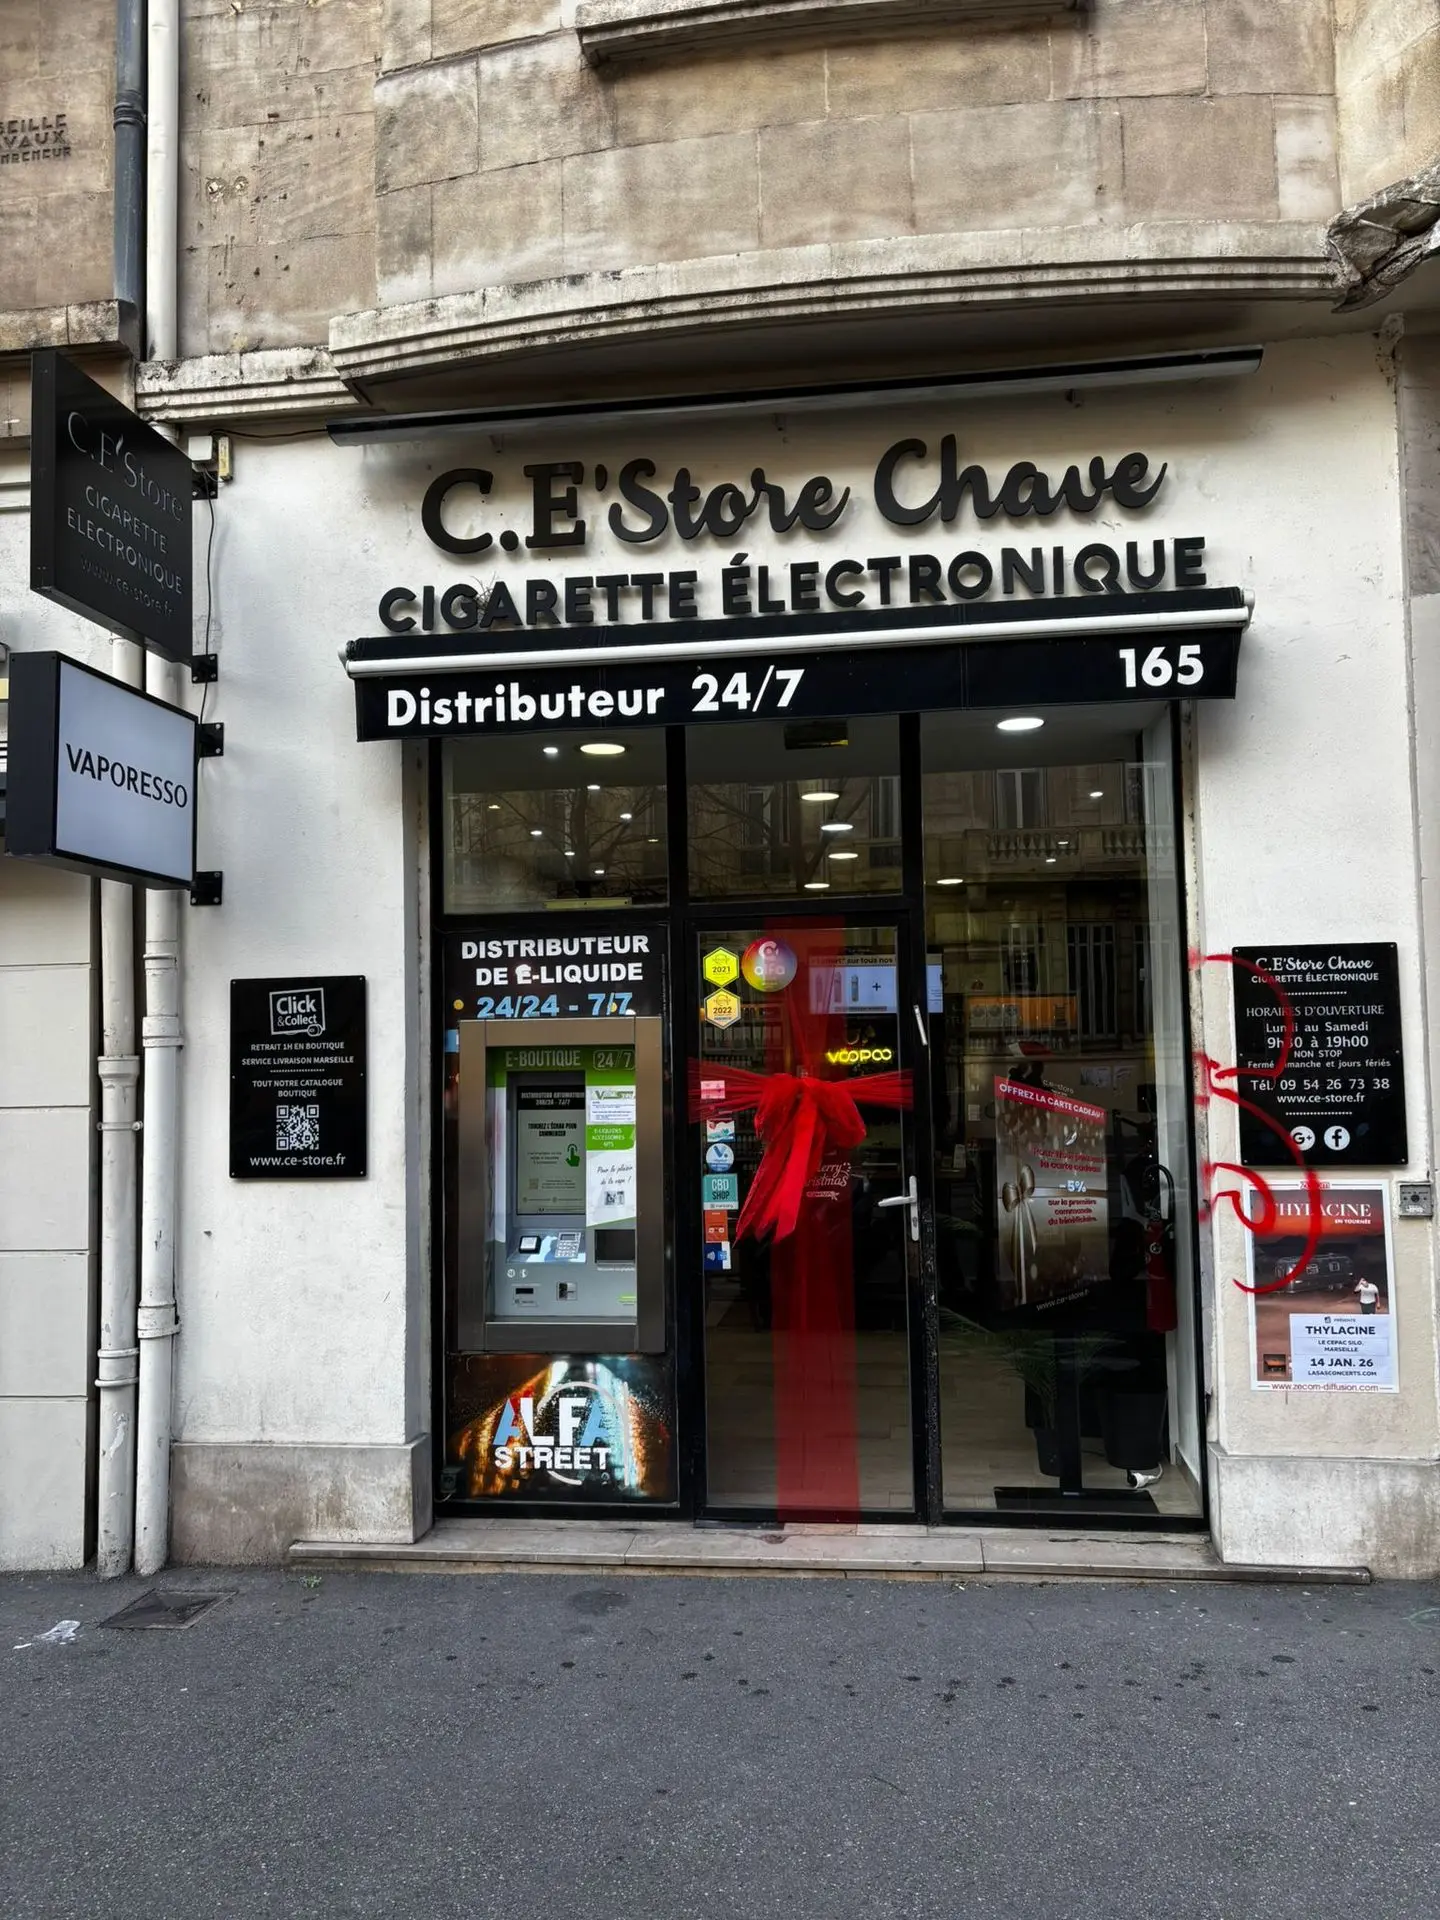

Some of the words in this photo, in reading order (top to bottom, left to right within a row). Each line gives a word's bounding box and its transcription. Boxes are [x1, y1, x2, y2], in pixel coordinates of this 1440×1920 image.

[0, 130, 66, 148] VAUX
[67, 411, 184, 522] C.E'Store
[420, 456, 851, 557] C.E'Store
[873, 433, 1168, 527] Chave
[85, 485, 168, 555] CIGARETTE
[67, 507, 183, 595] ELECTRONIQUE
[378, 569, 699, 635] CIGARETTE
[722, 536, 1208, 617] ÉLECTRONIQUE
[386, 680, 665, 728] Distributeur
[690, 668, 805, 714] 24/7
[1118, 644, 1205, 689] 165
[66, 743, 188, 809] VAPORESSO
[461, 935, 650, 960] DISTRIBUTEUR
[1255, 956, 1326, 972] C.E'Store
[1327, 956, 1374, 970] Chave
[476, 967, 508, 986] DE
[1305, 972, 1379, 983] ÉLECTRONIQUE
[276, 994, 316, 1016] Click
[477, 994, 559, 1019] 24/24
[588, 992, 633, 1016] 7/7
[1304, 1004, 1385, 1016] D'OUVERTURE
[277, 1014, 317, 1027] &Collect
[1266, 1022, 1299, 1033] Luni
[1304, 1024, 1319, 1033] au
[1325, 1021, 1369, 1032] Samedi
[250, 1043, 282, 1051] RETRAIT
[294, 1043, 304, 1051] EN
[305, 1041, 345, 1051] BOUTIQUE
[1310, 1035, 1319, 1048] à
[1326, 1035, 1369, 1047] 19h00
[505, 1050, 581, 1068] E-BOUTIQUE
[1294, 1050, 1315, 1058] NON
[1318, 1049, 1342, 1058] STOP
[241, 1058, 272, 1066] SERVICE
[273, 1056, 312, 1065] LIVRAISON
[313, 1055, 354, 1064] MARSEILLE
[1248, 1060, 1275, 1069] Fermé
[1281, 1060, 1321, 1069] imanche
[1338, 1060, 1361, 1070] jours
[1365, 1059, 1391, 1068] fériés
[252, 1080, 272, 1088] TOUT
[300, 1079, 343, 1087] CATALOGUE
[1250, 1079, 1274, 1091] Tél.
[1280, 1079, 1297, 1091] 09
[1303, 1079, 1320, 1090] 54
[1326, 1079, 1342, 1090] 26
[1349, 1078, 1365, 1090] 73
[1372, 1078, 1390, 1089] 38
[278, 1089, 317, 1098] BOUTIQUE
[999, 1083, 1035, 1100] OFFREZ
[1035, 1093, 1046, 1103] LA
[1047, 1098, 1073, 1111] CARTE
[1277, 1093, 1365, 1103] www.ce-store.fr
[250, 1153, 346, 1166] www.ce-store.fr
[711, 1179, 729, 1191] CBD
[711, 1191, 730, 1200] SHOP
[1306, 1326, 1376, 1335] THYLACINE
[1310, 1358, 1325, 1367] 14
[1327, 1358, 1356, 1367] JAN.
[1359, 1358, 1374, 1367] 26
[1271, 1382, 1379, 1392] www.zecom-diffusion.com
[492, 1397, 609, 1446] ALFA
[494, 1446, 612, 1470] STREET
